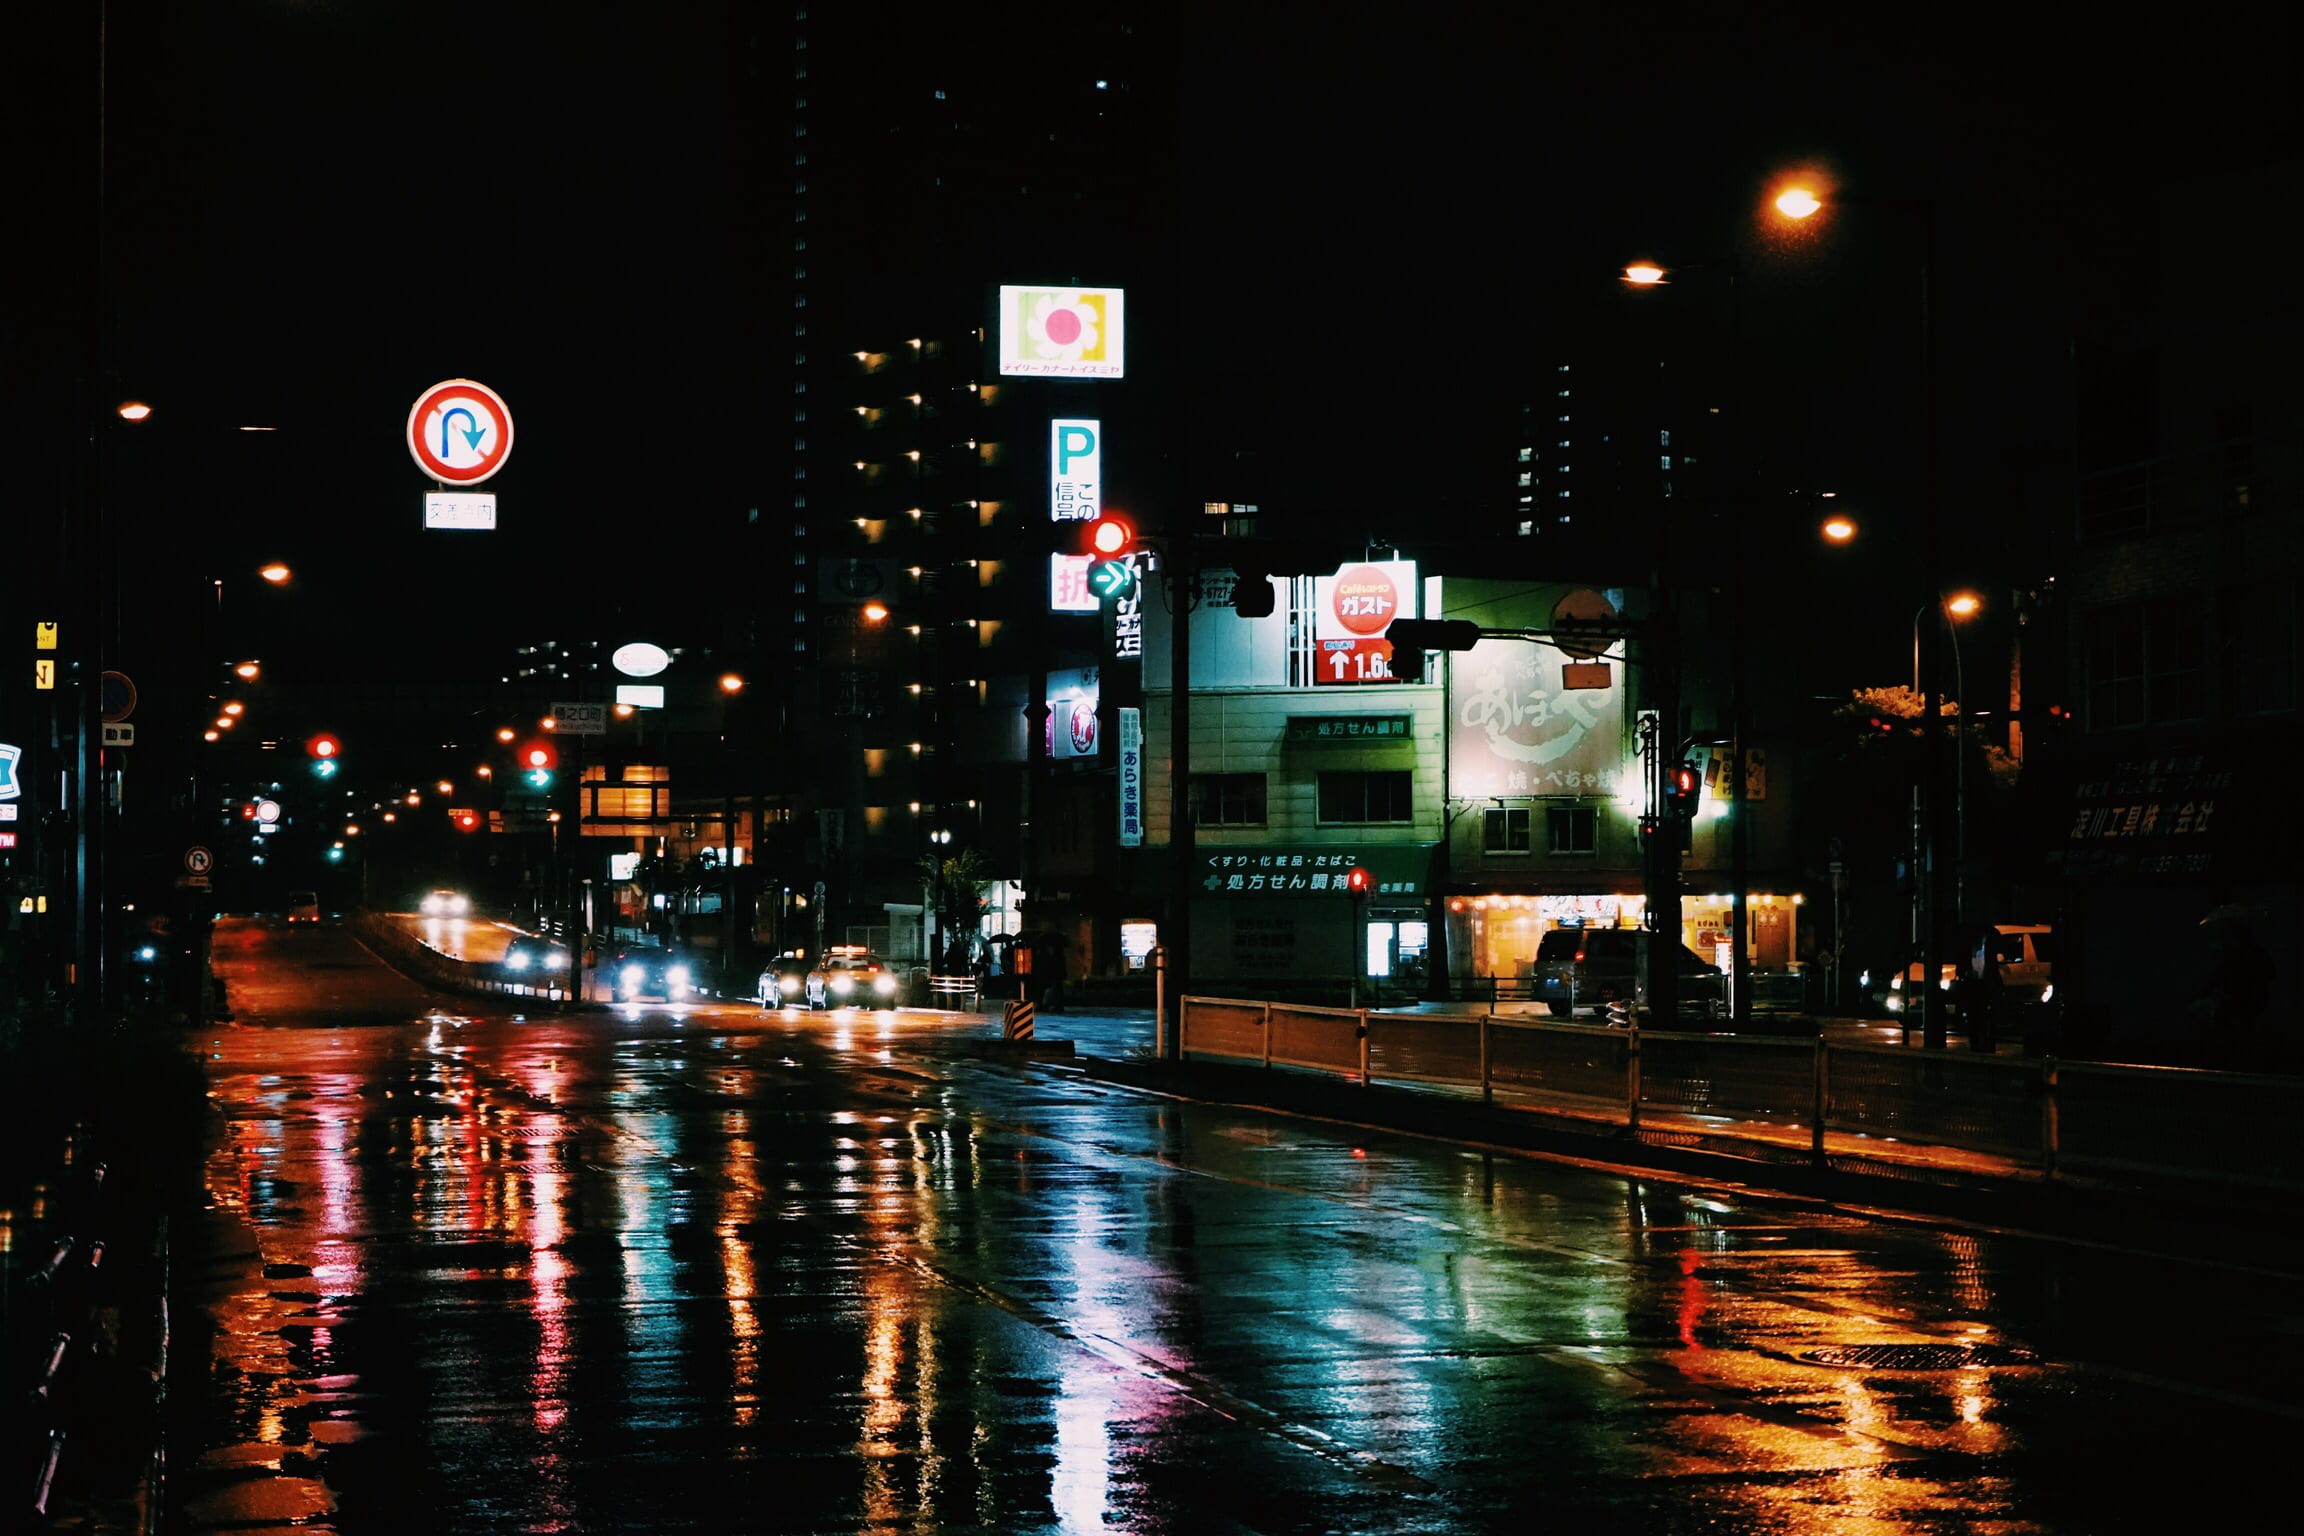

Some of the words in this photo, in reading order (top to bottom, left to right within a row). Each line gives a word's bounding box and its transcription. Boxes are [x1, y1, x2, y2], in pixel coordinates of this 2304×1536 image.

[1058, 425, 1096, 476] P
[1077, 483, 1096, 521] この
[1341, 596, 1392, 616] ガスト
[1318, 721, 1404, 736] 処方せん調剤
[1124, 751, 1138, 835] あらき薬局
[1208, 855, 1357, 867] くすり・化粧品・たばこ
[1226, 873, 1350, 891] 処方せん調剤
